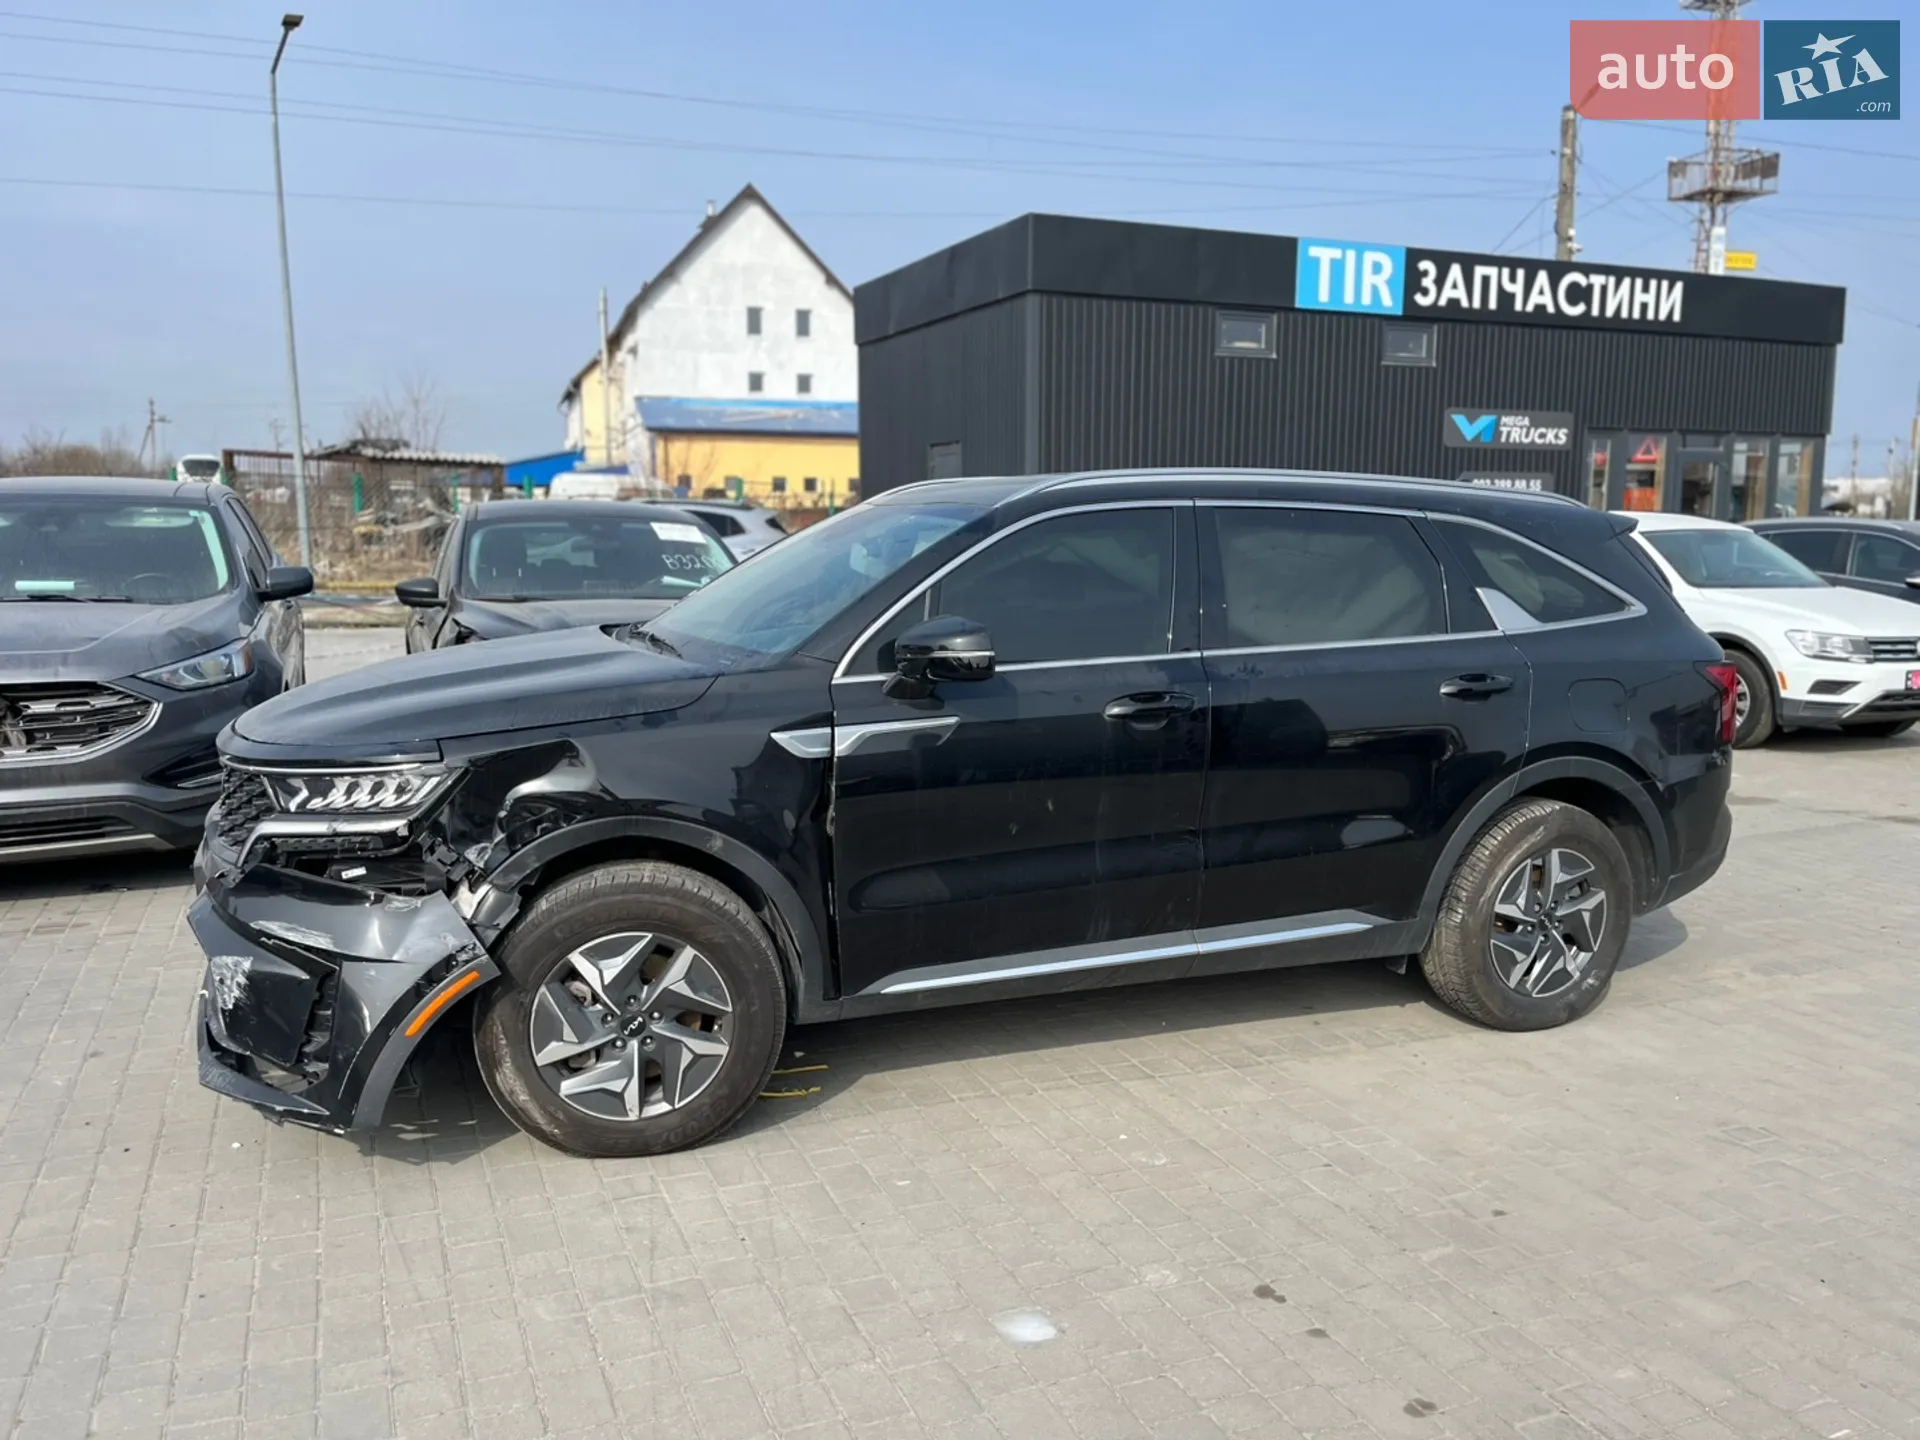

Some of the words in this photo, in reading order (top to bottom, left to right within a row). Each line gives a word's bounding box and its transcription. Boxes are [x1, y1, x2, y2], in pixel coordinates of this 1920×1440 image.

[1308, 246, 1394, 307] TIR
[1413, 259, 1684, 323] ЗАПЧАСТИНИ
[1499, 427, 1569, 445] TRUCKS
[1500, 415, 1530, 427] MEGA
